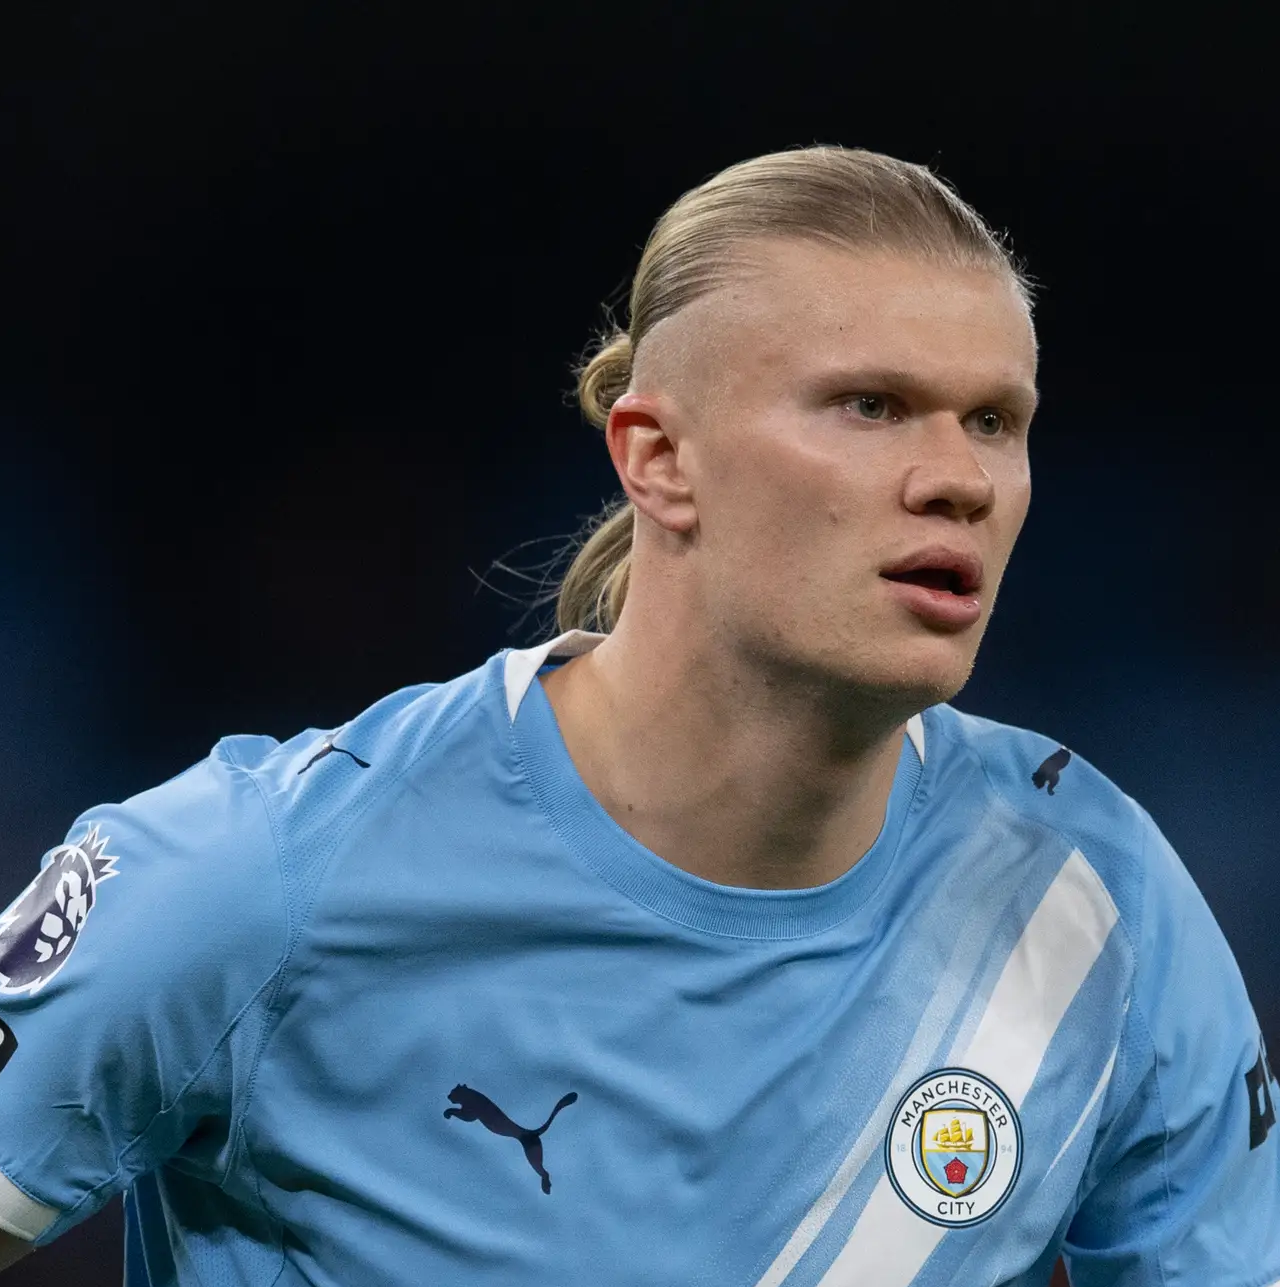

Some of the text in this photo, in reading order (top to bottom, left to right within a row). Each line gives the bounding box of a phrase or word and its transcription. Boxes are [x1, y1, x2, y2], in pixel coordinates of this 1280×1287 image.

[901, 1080, 1008, 1129] MANCHESTER
[896, 1143, 906, 1153] 18
[1001, 1143, 1013, 1154] 94
[937, 1201, 976, 1215] CITY
